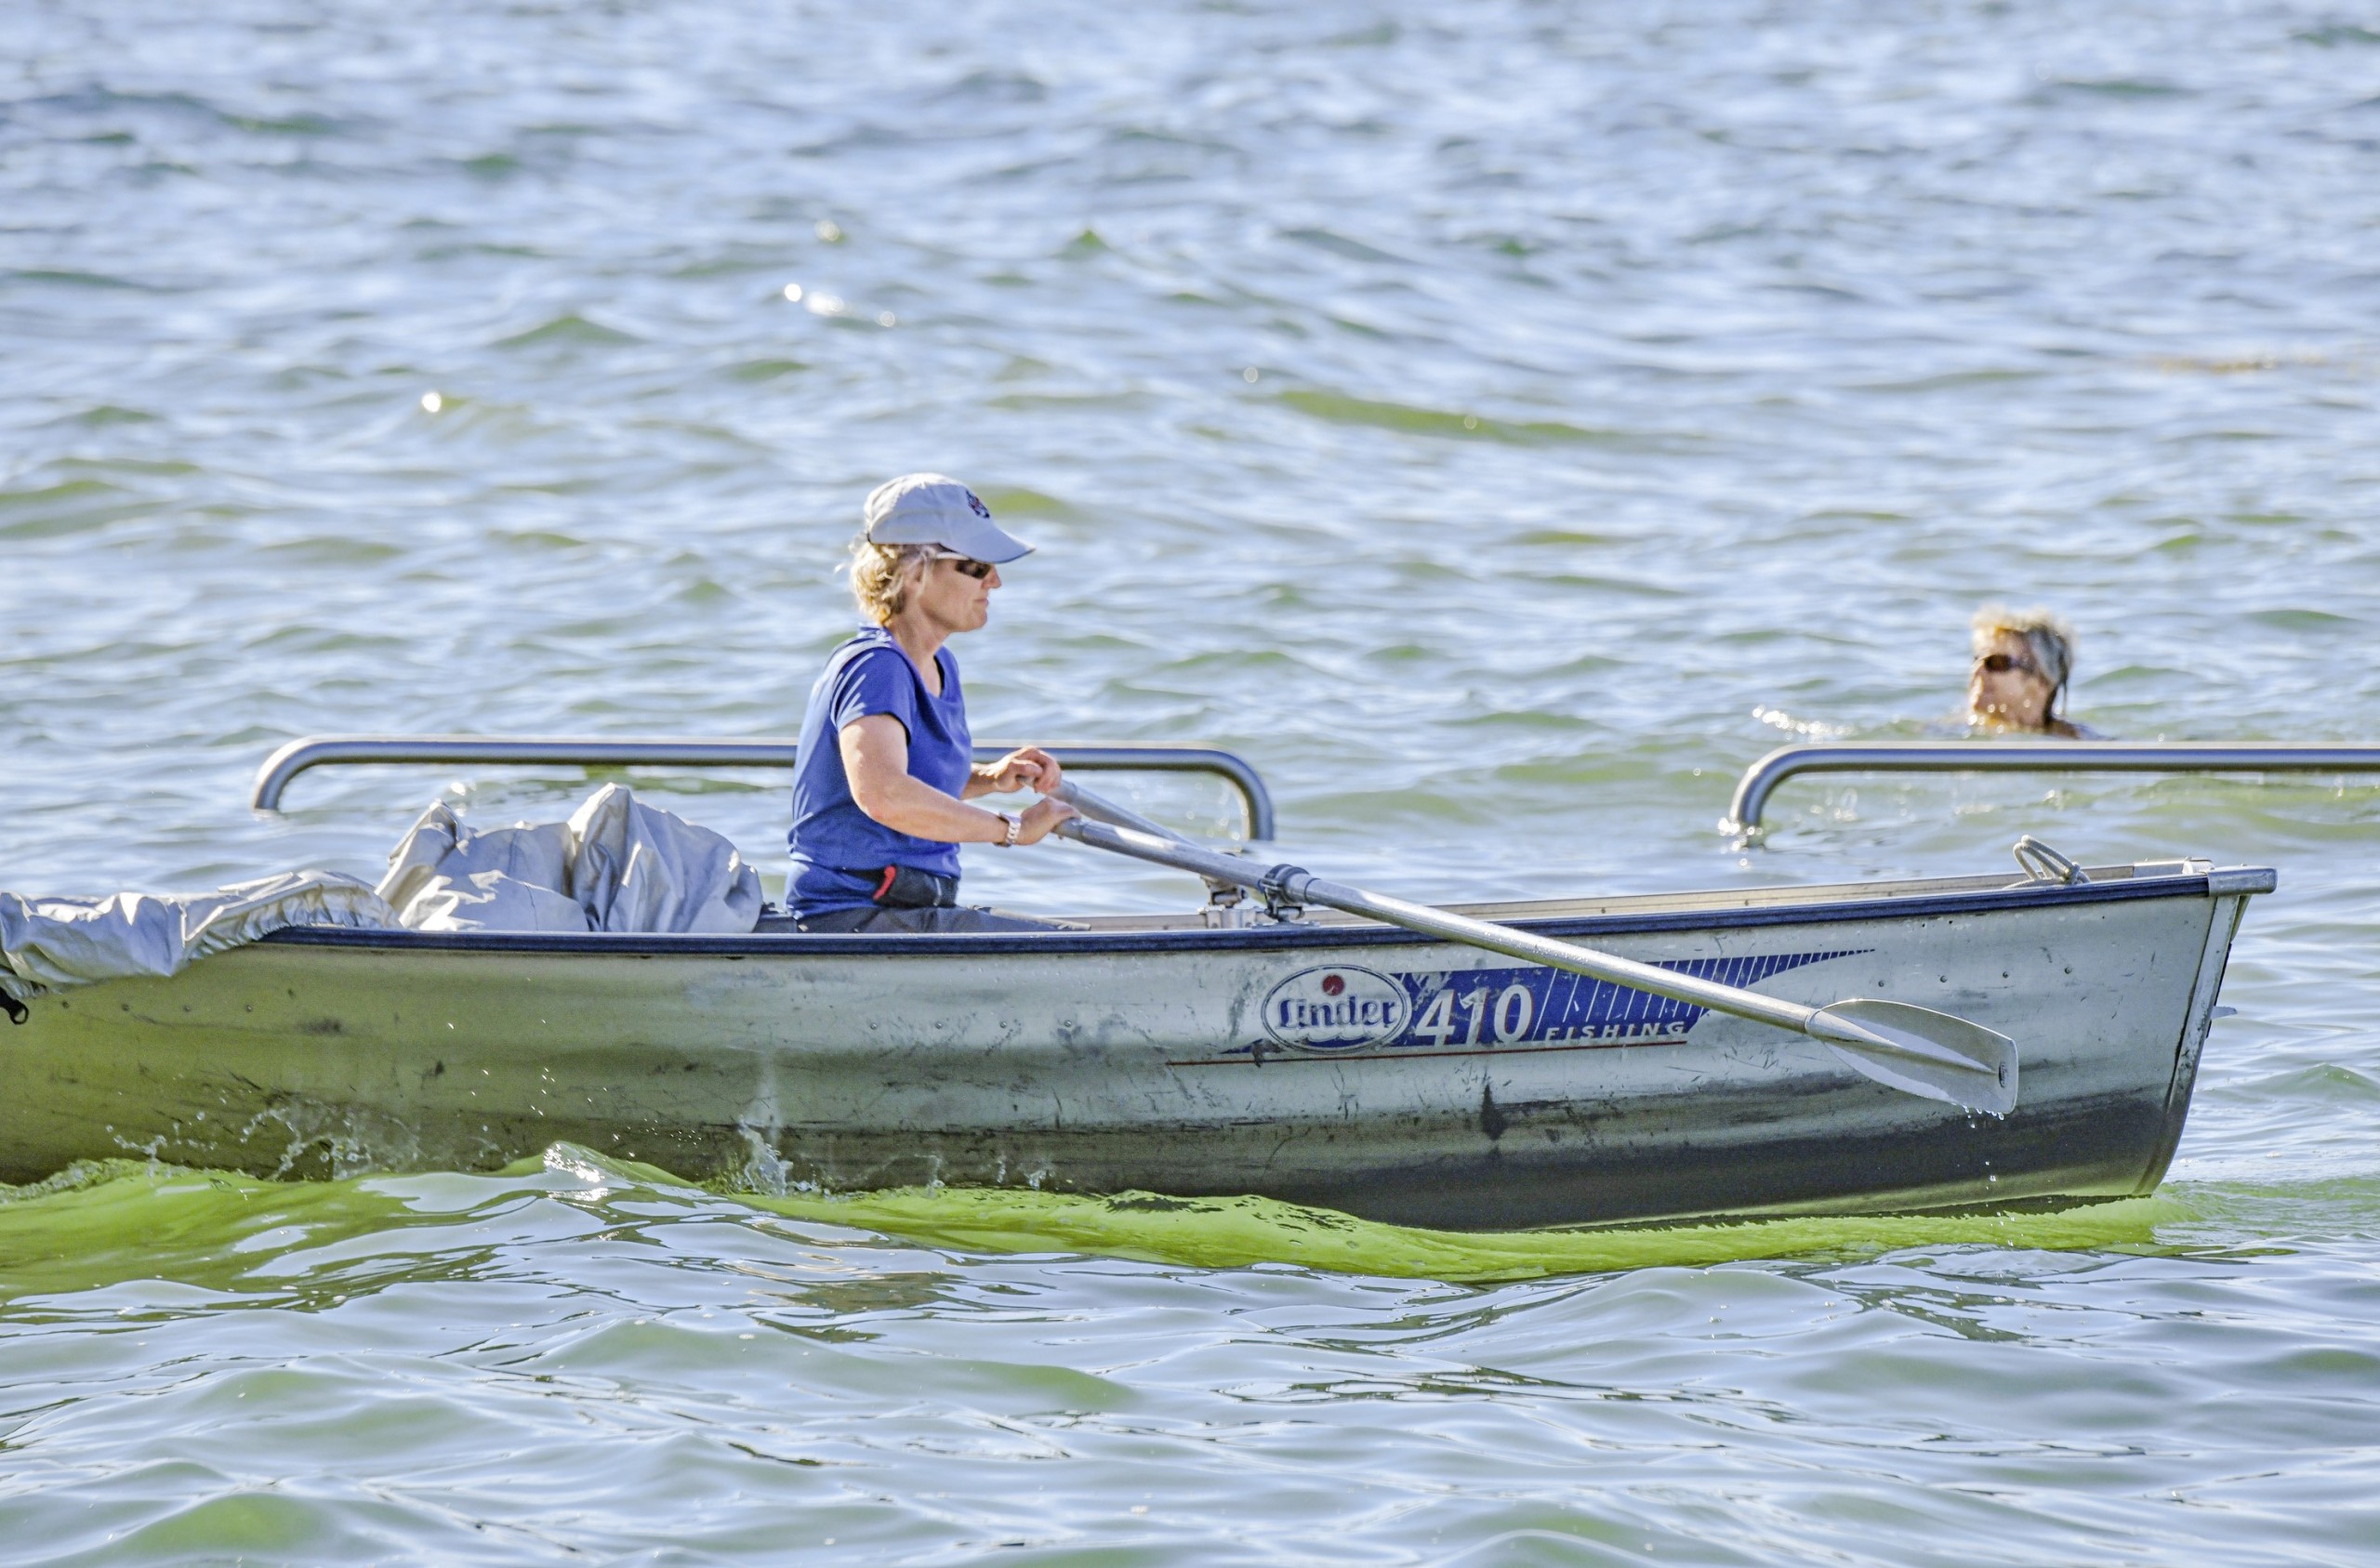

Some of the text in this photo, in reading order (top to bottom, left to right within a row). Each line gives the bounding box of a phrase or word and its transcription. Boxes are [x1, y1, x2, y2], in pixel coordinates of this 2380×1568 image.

[1276, 995, 1396, 1029] Linder
[1414, 983, 1686, 1047] 410 FISHING
